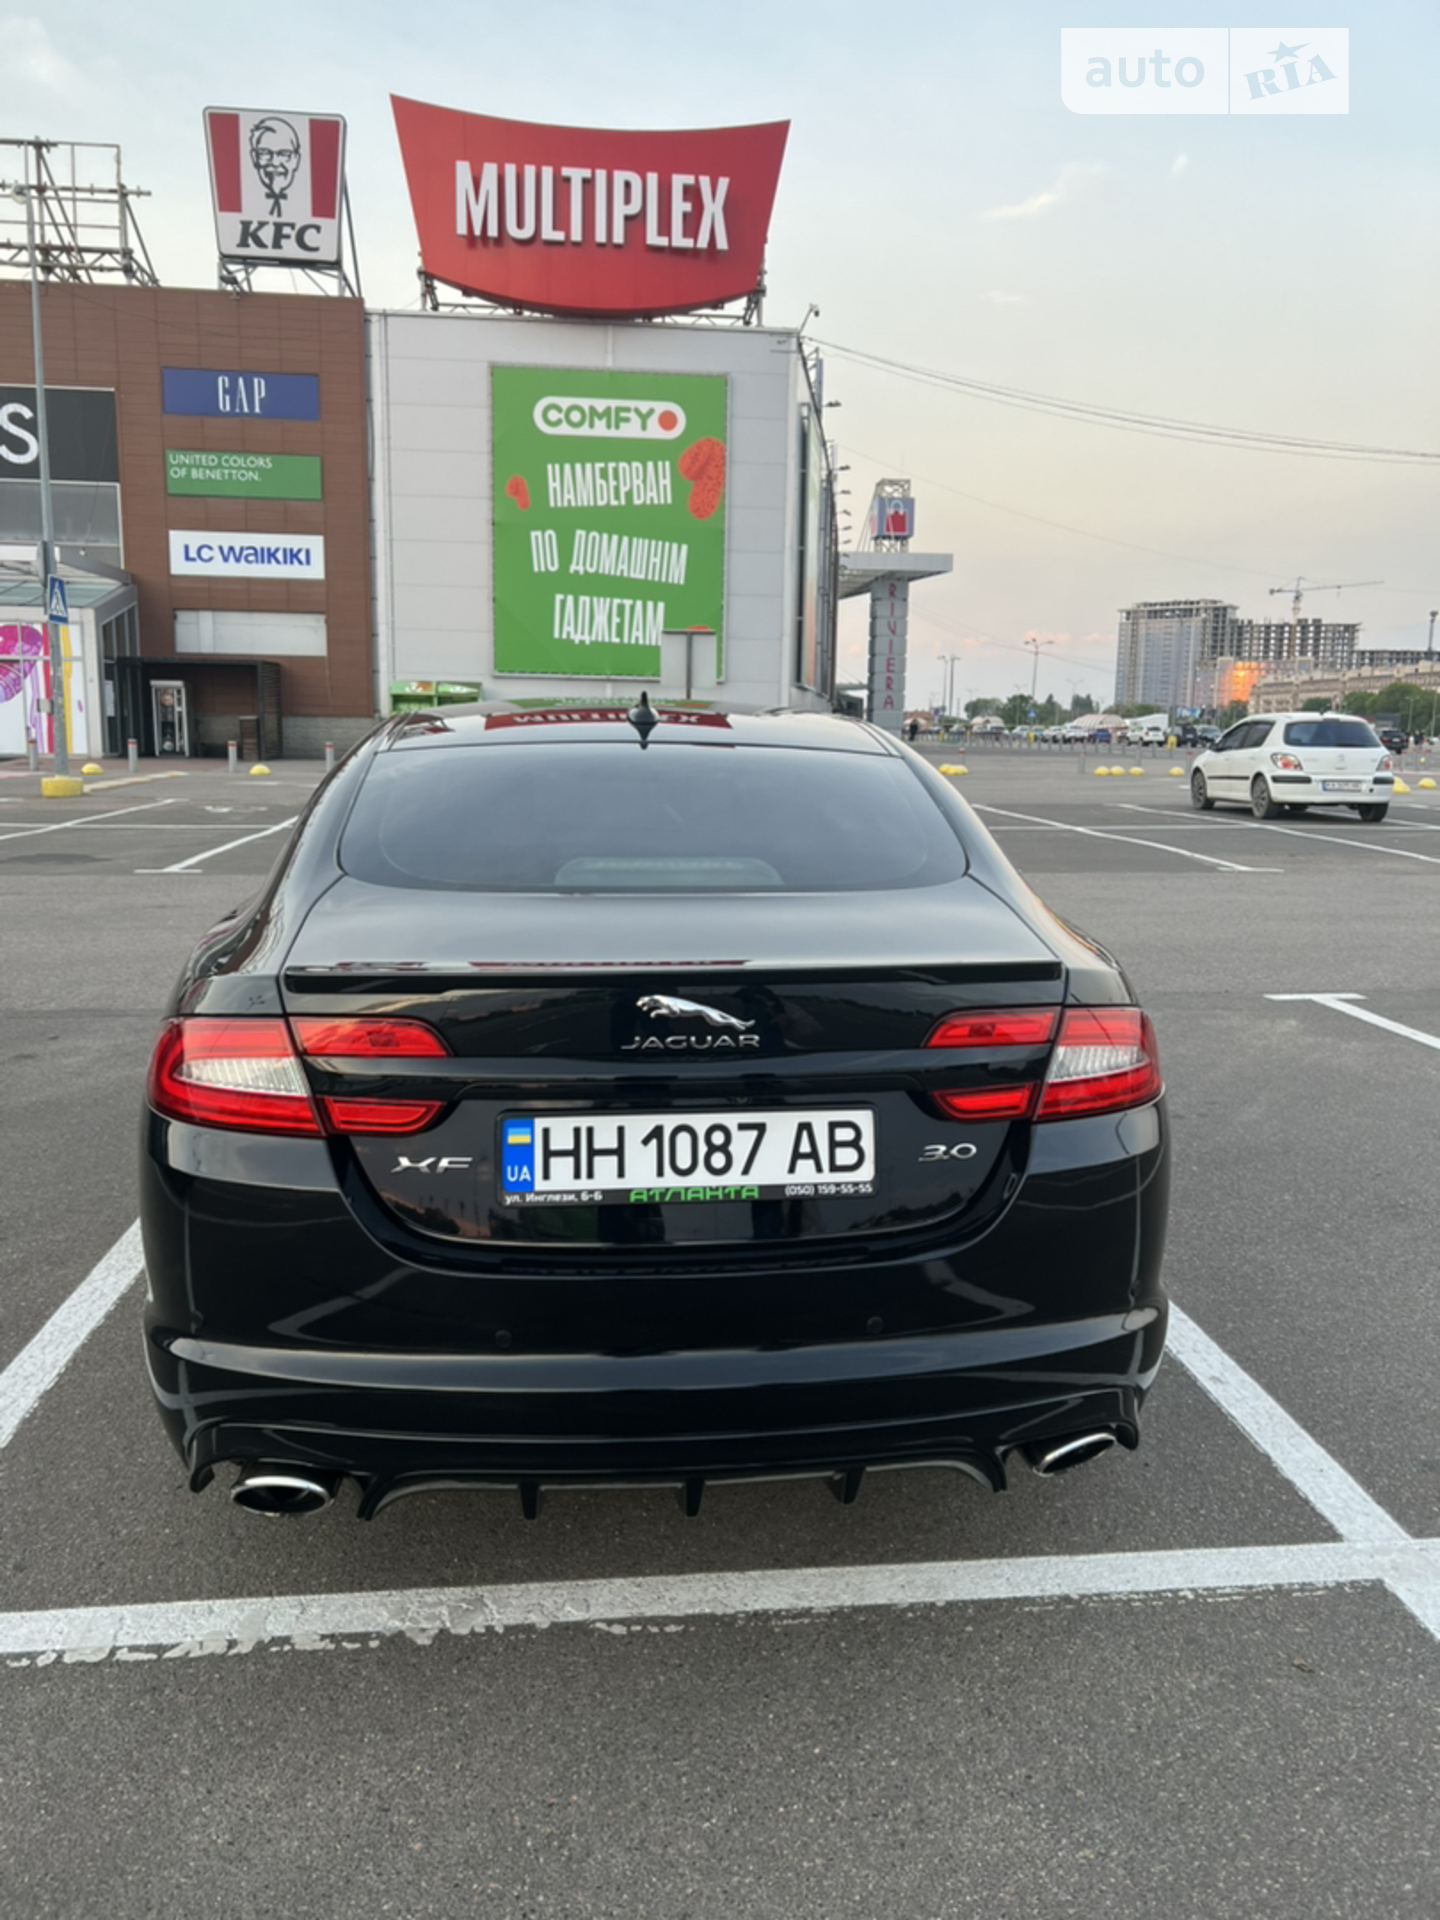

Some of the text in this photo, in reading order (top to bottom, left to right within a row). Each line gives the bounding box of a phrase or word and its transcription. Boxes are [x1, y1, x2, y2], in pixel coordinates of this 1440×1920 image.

[455, 160, 730, 250] MULTIPLEX
[236, 219, 322, 252] KFC
[217, 375, 266, 414] GAP
[541, 402, 655, 432] COMFY
[169, 453, 273, 469] UNITED COLORS
[169, 467, 262, 482] OF BENETTON.
[547, 460, 673, 508] НАМБЕРВАН
[183, 543, 215, 563] LC
[530, 529, 689, 585] ПО ДОМАШНІМ
[553, 593, 666, 647] ГАДЖЕТАМ
[882, 582, 897, 710] RIVIERA
[620, 1034, 761, 1050] JAGUAR
[390, 1156, 474, 1174] XF
[541, 1120, 866, 1181] HH 1087 AB
[918, 1142, 978, 1162] 3.0
[506, 1165, 532, 1182] UA
[629, 1185, 760, 1203] АТЛАНТА
